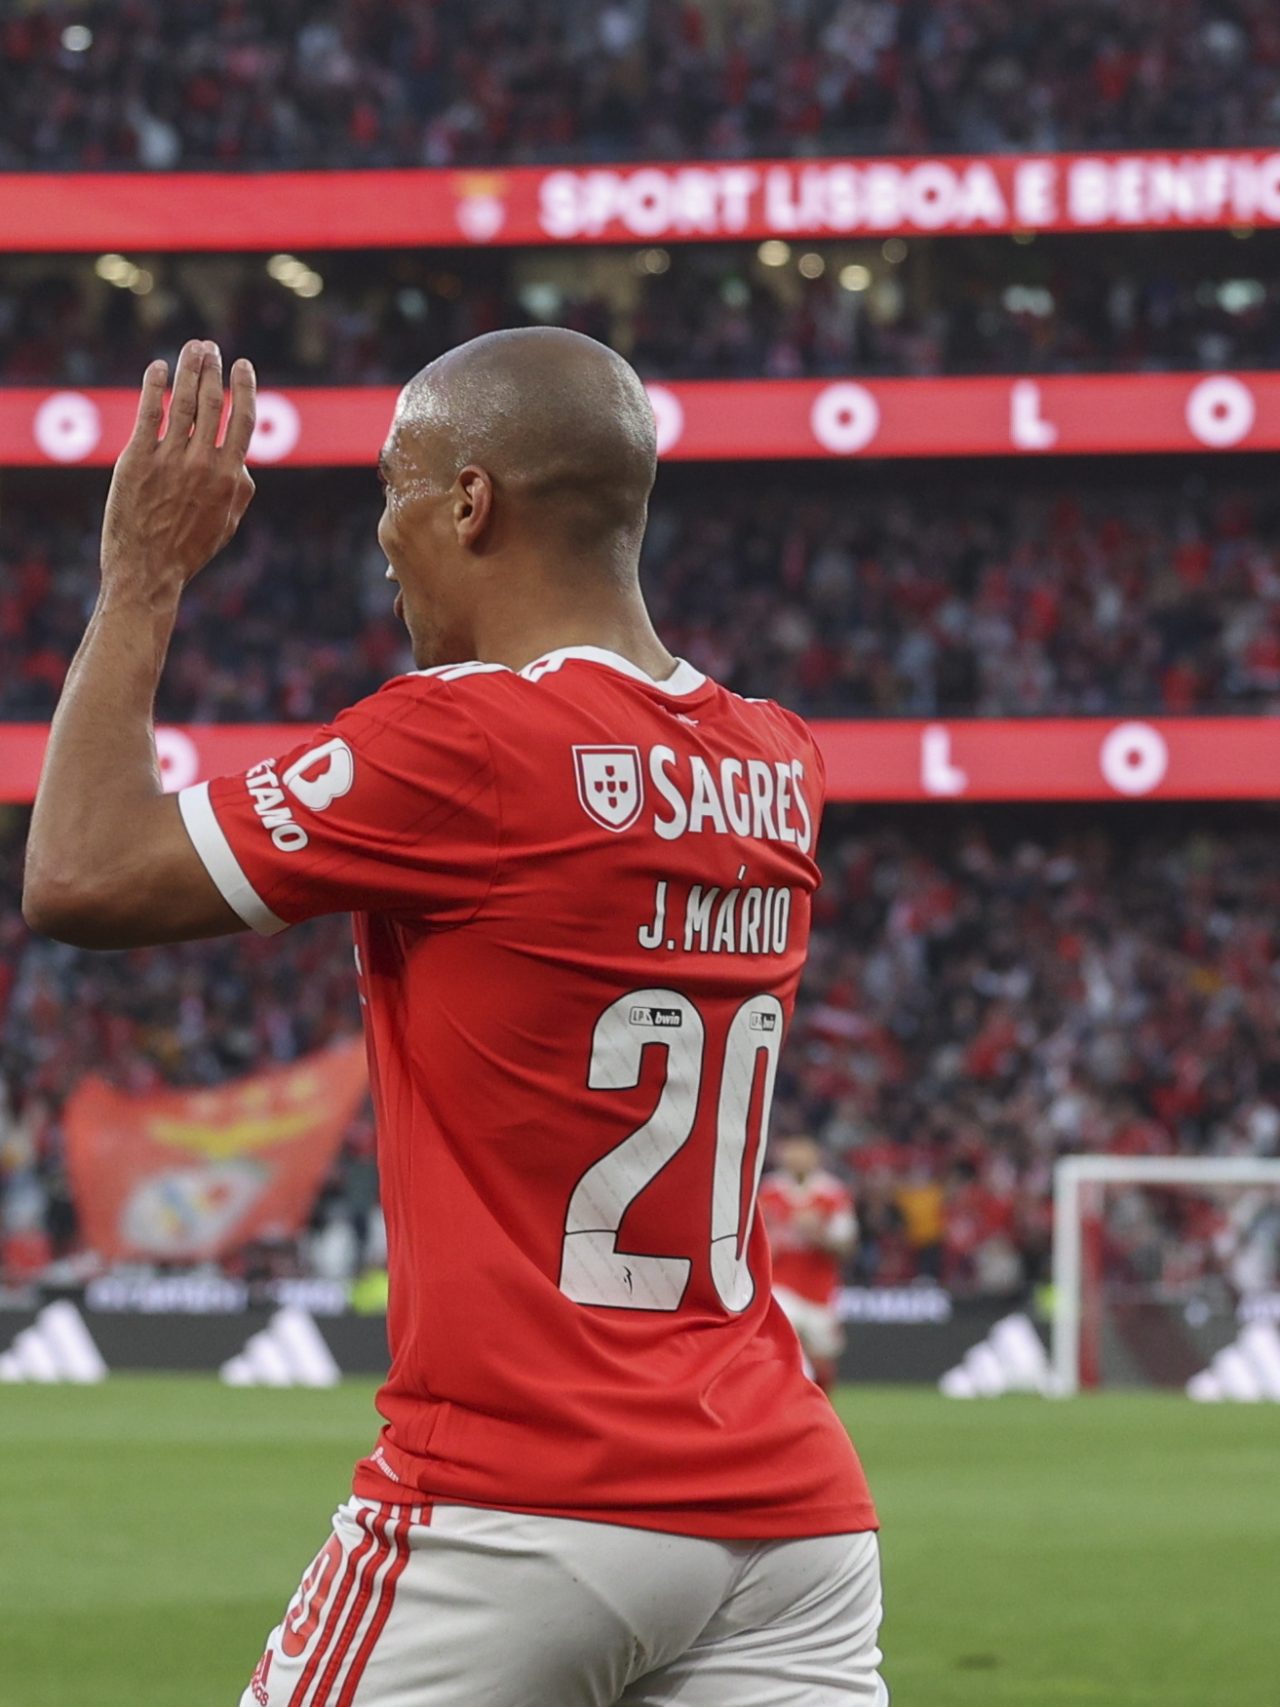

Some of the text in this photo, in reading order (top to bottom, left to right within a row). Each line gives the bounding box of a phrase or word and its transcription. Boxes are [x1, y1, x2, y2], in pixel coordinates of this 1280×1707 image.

[539, 168, 758, 237] SPORT
[765, 162, 1006, 232] LISBOA
[1013, 159, 1055, 226] E
[811, 383, 879, 452] O
[1010, 381, 1056, 449] L
[1186, 376, 1255, 446] O
[921, 727, 966, 796] L
[1100, 723, 1168, 794] O
[649, 744, 812, 855] SAGRES
[638, 864, 791, 954] J.MÁRIO
[654, 1011, 681, 1026] bwin
[558, 987, 784, 1313] 20
